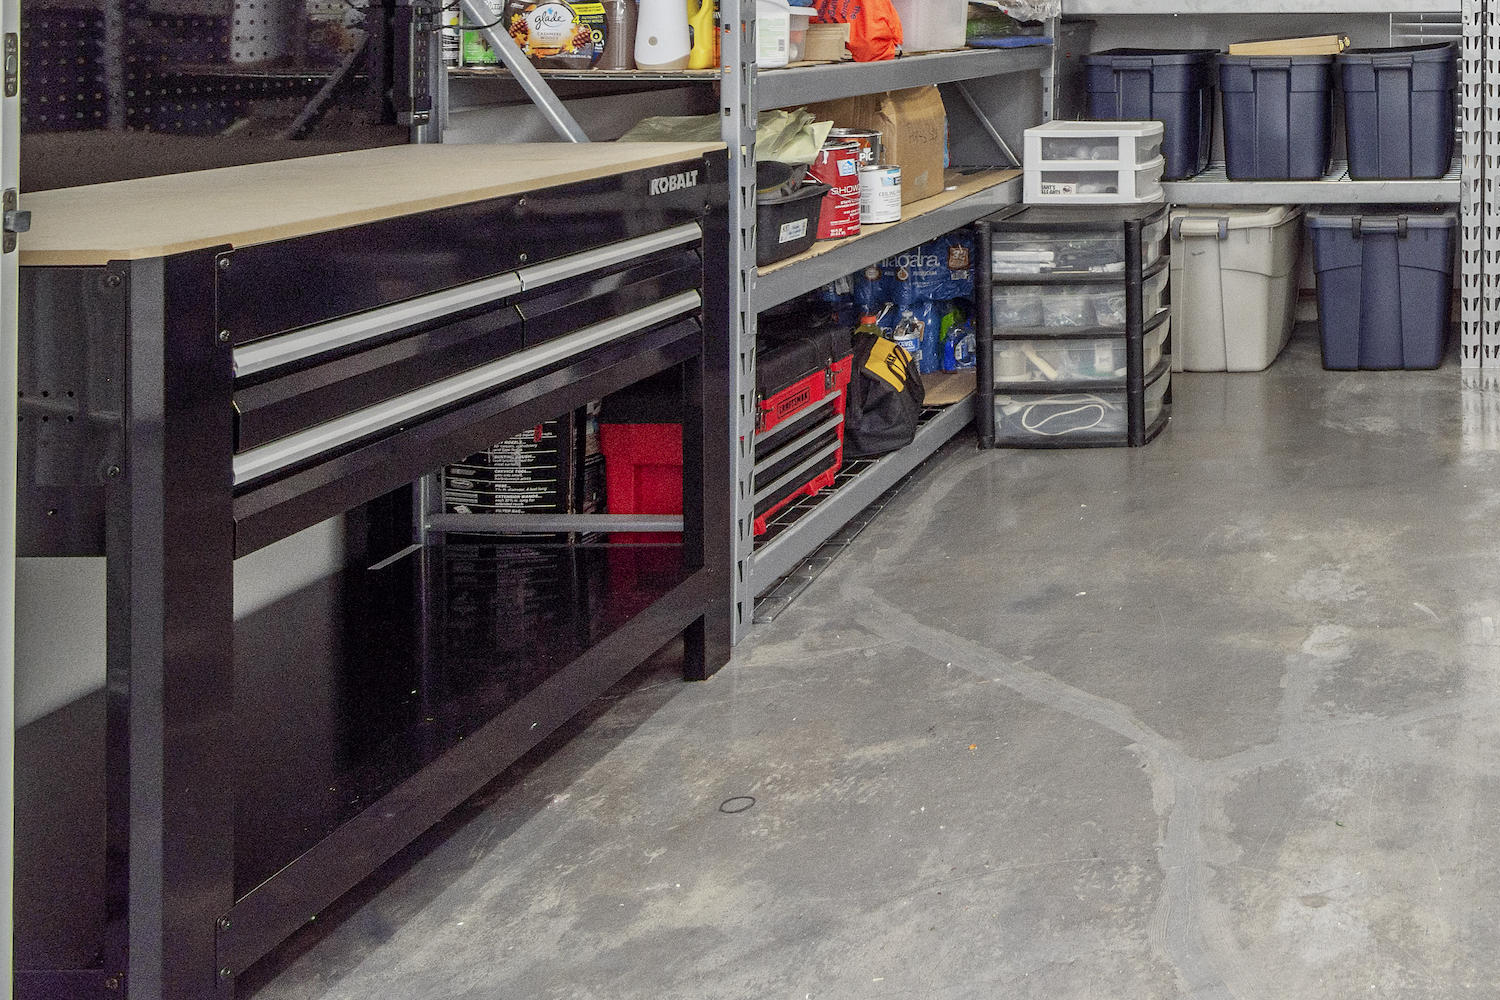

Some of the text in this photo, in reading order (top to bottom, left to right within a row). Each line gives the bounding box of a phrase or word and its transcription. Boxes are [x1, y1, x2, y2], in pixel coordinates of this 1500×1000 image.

[535, 11, 566, 30] glade
[572, 16, 581, 24] 4
[649, 169, 698, 196] KOBALT
[830, 184, 860, 197] SHOW
[883, 252, 940, 273] iagara
